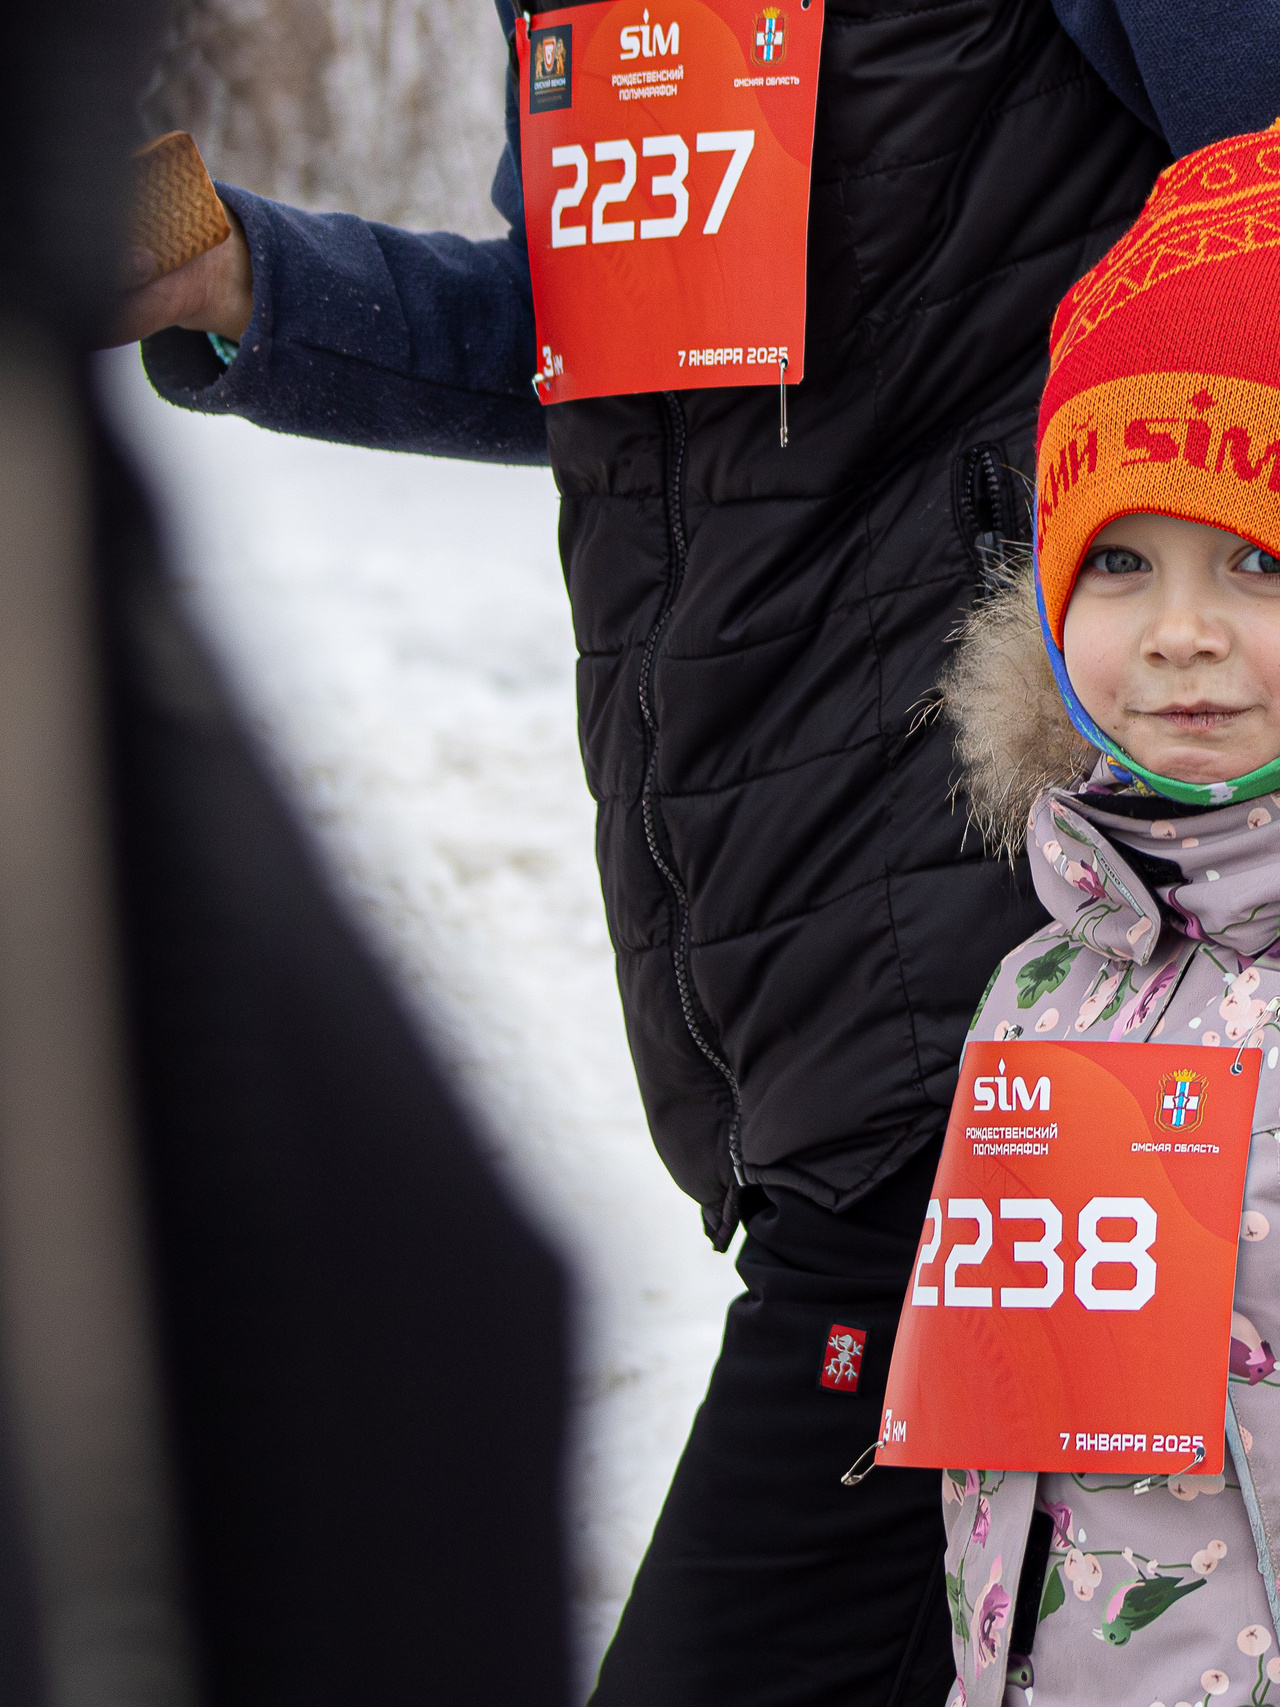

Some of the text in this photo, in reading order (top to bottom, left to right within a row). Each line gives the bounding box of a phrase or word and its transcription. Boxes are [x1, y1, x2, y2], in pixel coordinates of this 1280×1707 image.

[611, 65, 684, 87] РОЖДЕСТВЕНСКИЙ
[733, 76, 800, 88] ОМСКАЯ ОБЛАСТЬ
[618, 83, 678, 101] ПОЛУМАРАФОН
[551, 130, 755, 248] 2237
[542, 345, 554, 377] 3
[678, 347, 789, 367] 7 ЯНВАРЯ 2025
[965, 1122, 1058, 1141] РОЖДЕСТВЕНСКИЙ
[972, 1142, 1049, 1156] ПОЛУМАРАФОН
[1131, 1142, 1220, 1154] ОМСКАЯ ОБЛАСТЬ
[911, 1196, 1158, 1311] 2238
[882, 1408, 893, 1442] 3
[1059, 1433, 1205, 1454] 7 ЯНВАРЯ 2025
